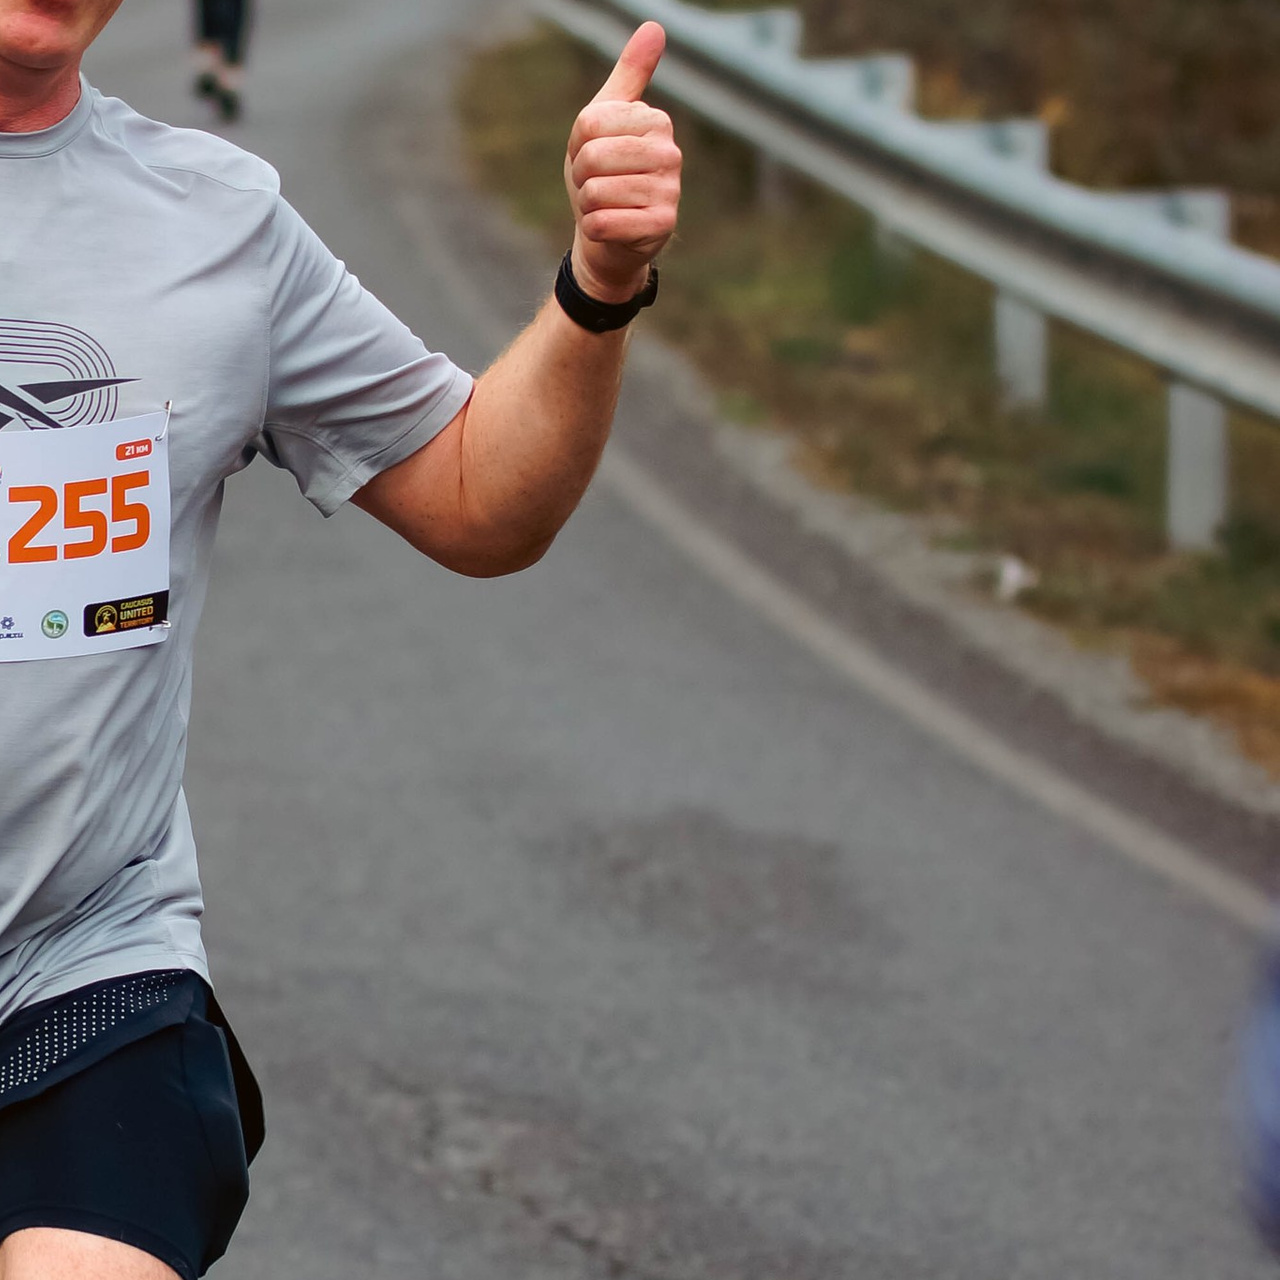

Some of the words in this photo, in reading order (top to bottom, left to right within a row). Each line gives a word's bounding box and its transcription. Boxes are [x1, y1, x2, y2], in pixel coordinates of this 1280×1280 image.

[125, 446, 135, 456] 21
[8, 470, 151, 564] 255
[120, 597, 154, 610] CAUCASUS
[120, 606, 154, 620] UNITED
